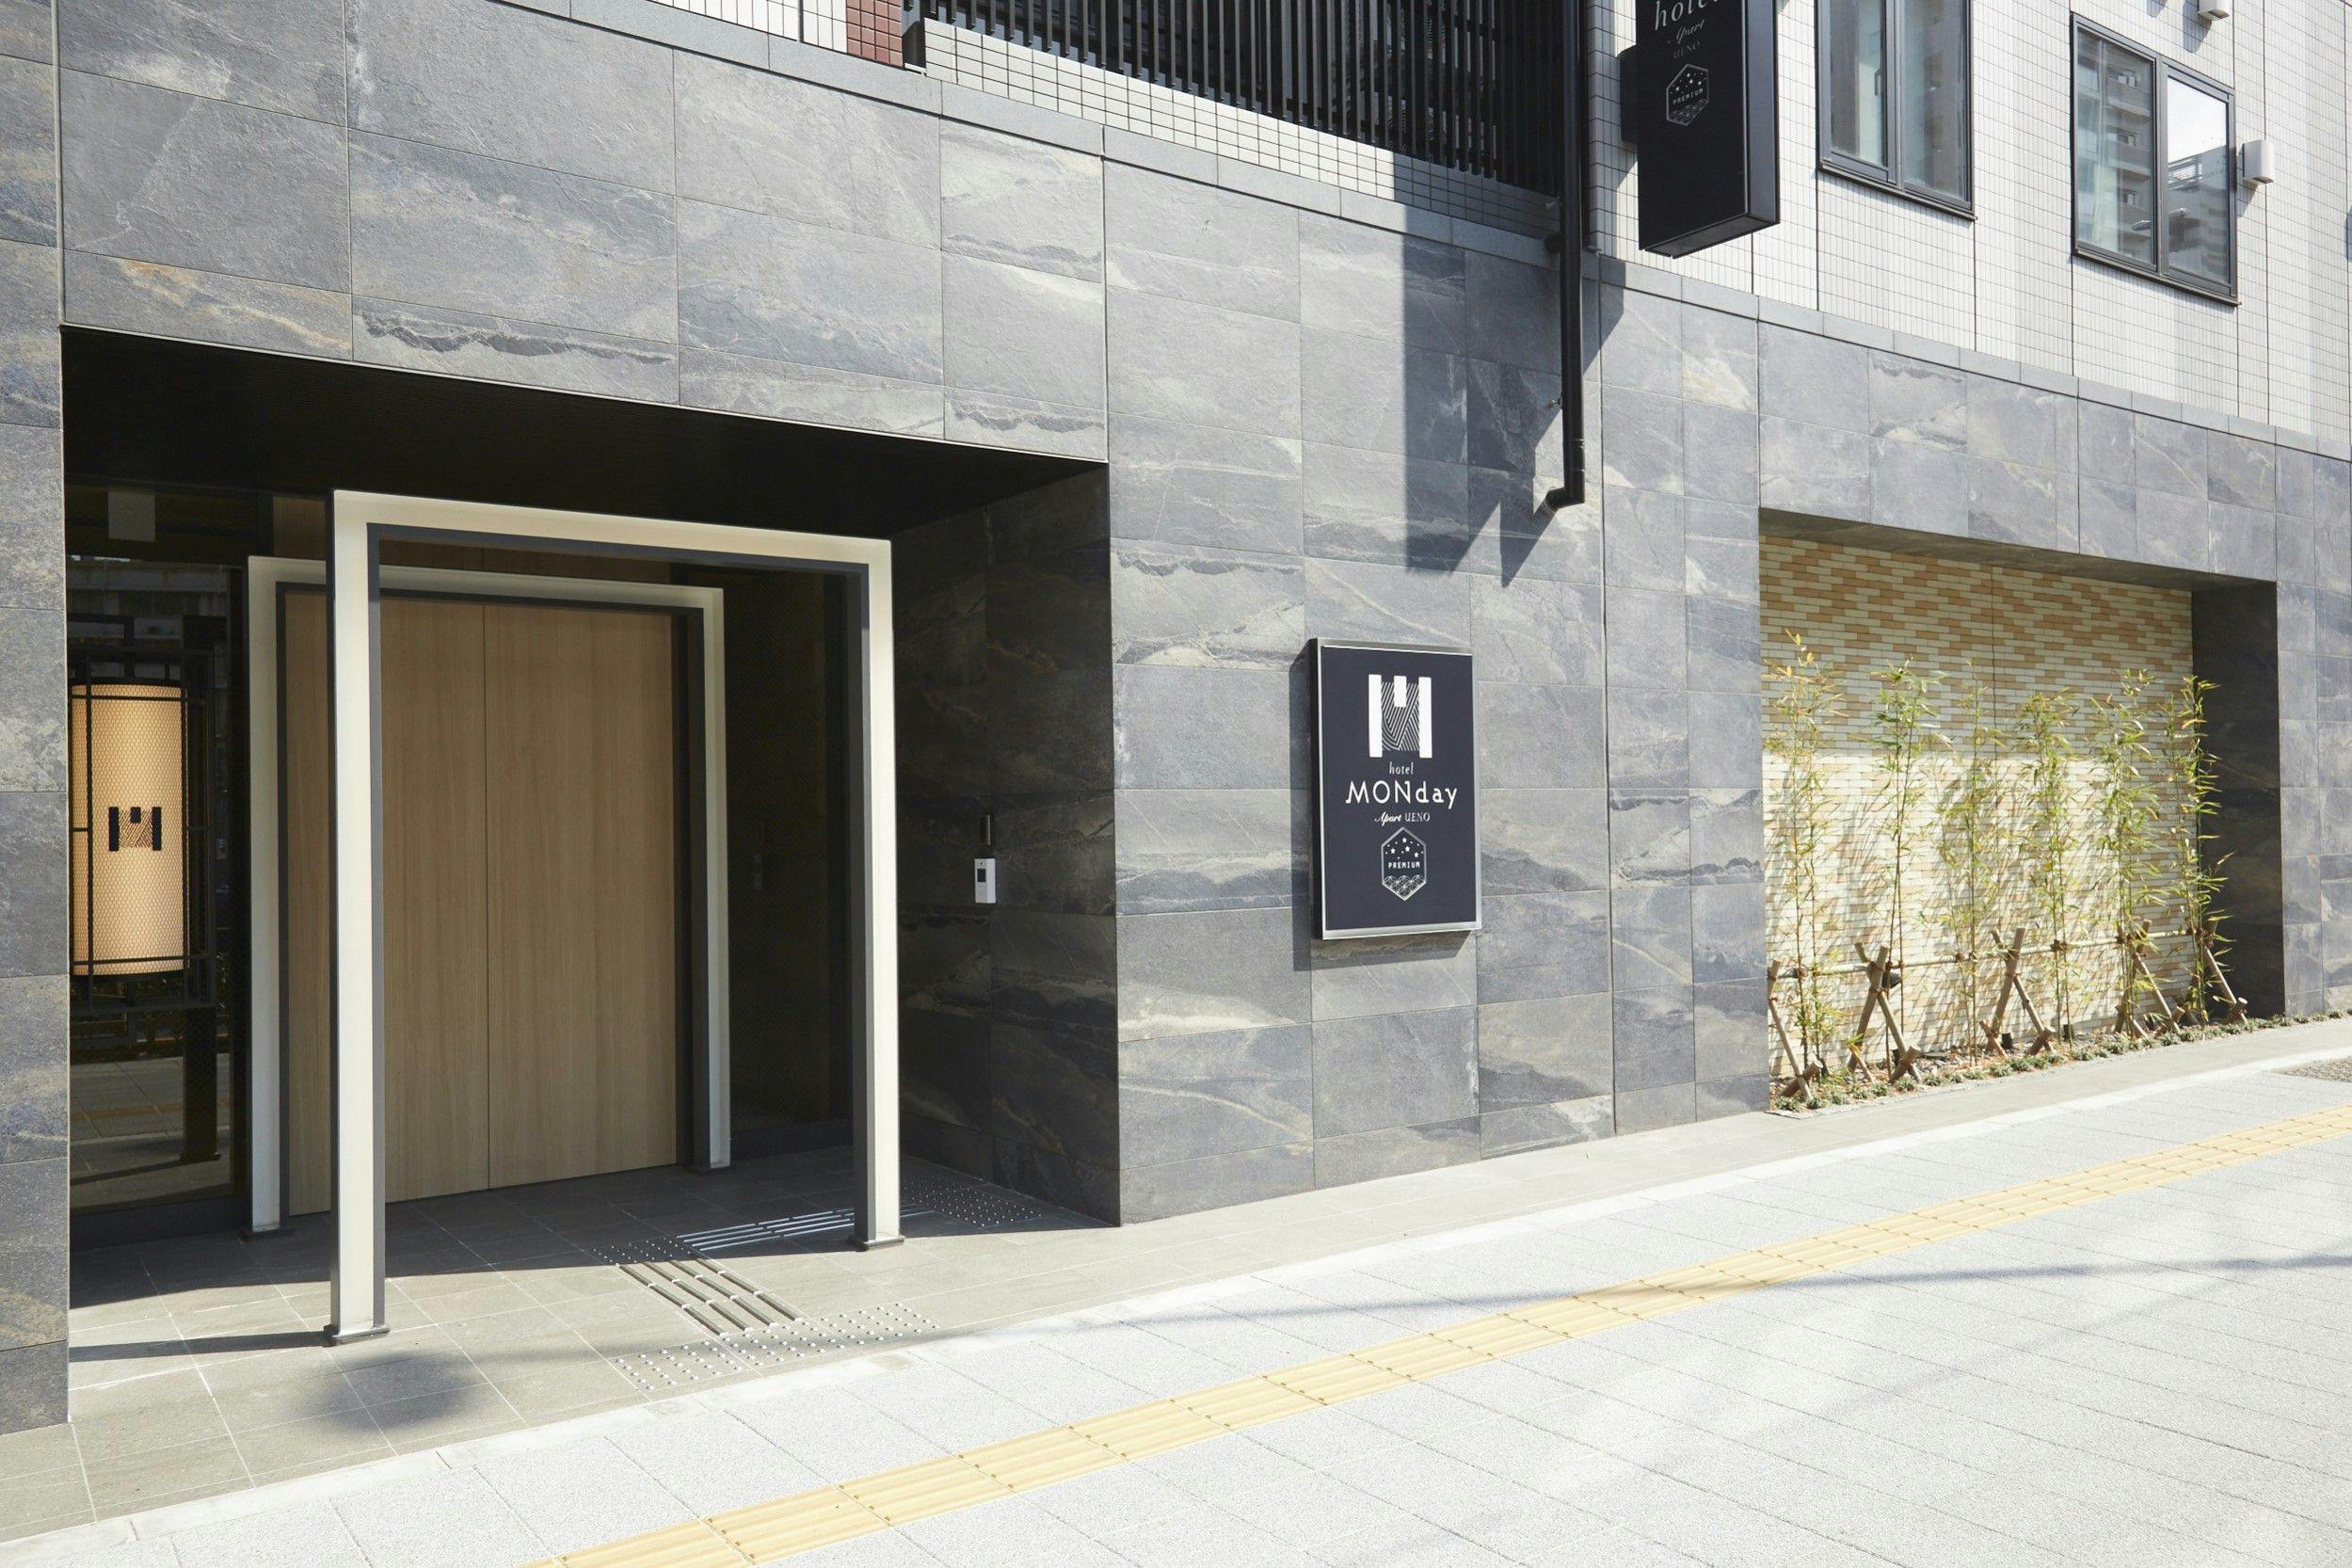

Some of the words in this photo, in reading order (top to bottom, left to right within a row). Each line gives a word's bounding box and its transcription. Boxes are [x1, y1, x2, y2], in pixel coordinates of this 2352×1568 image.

[1672, 88, 1704, 105] PREMIUM
[1388, 761, 1414, 775] hotel
[1345, 780, 1458, 809] MONday
[1374, 811, 1402, 826] Apart
[1404, 812, 1431, 822] UENO
